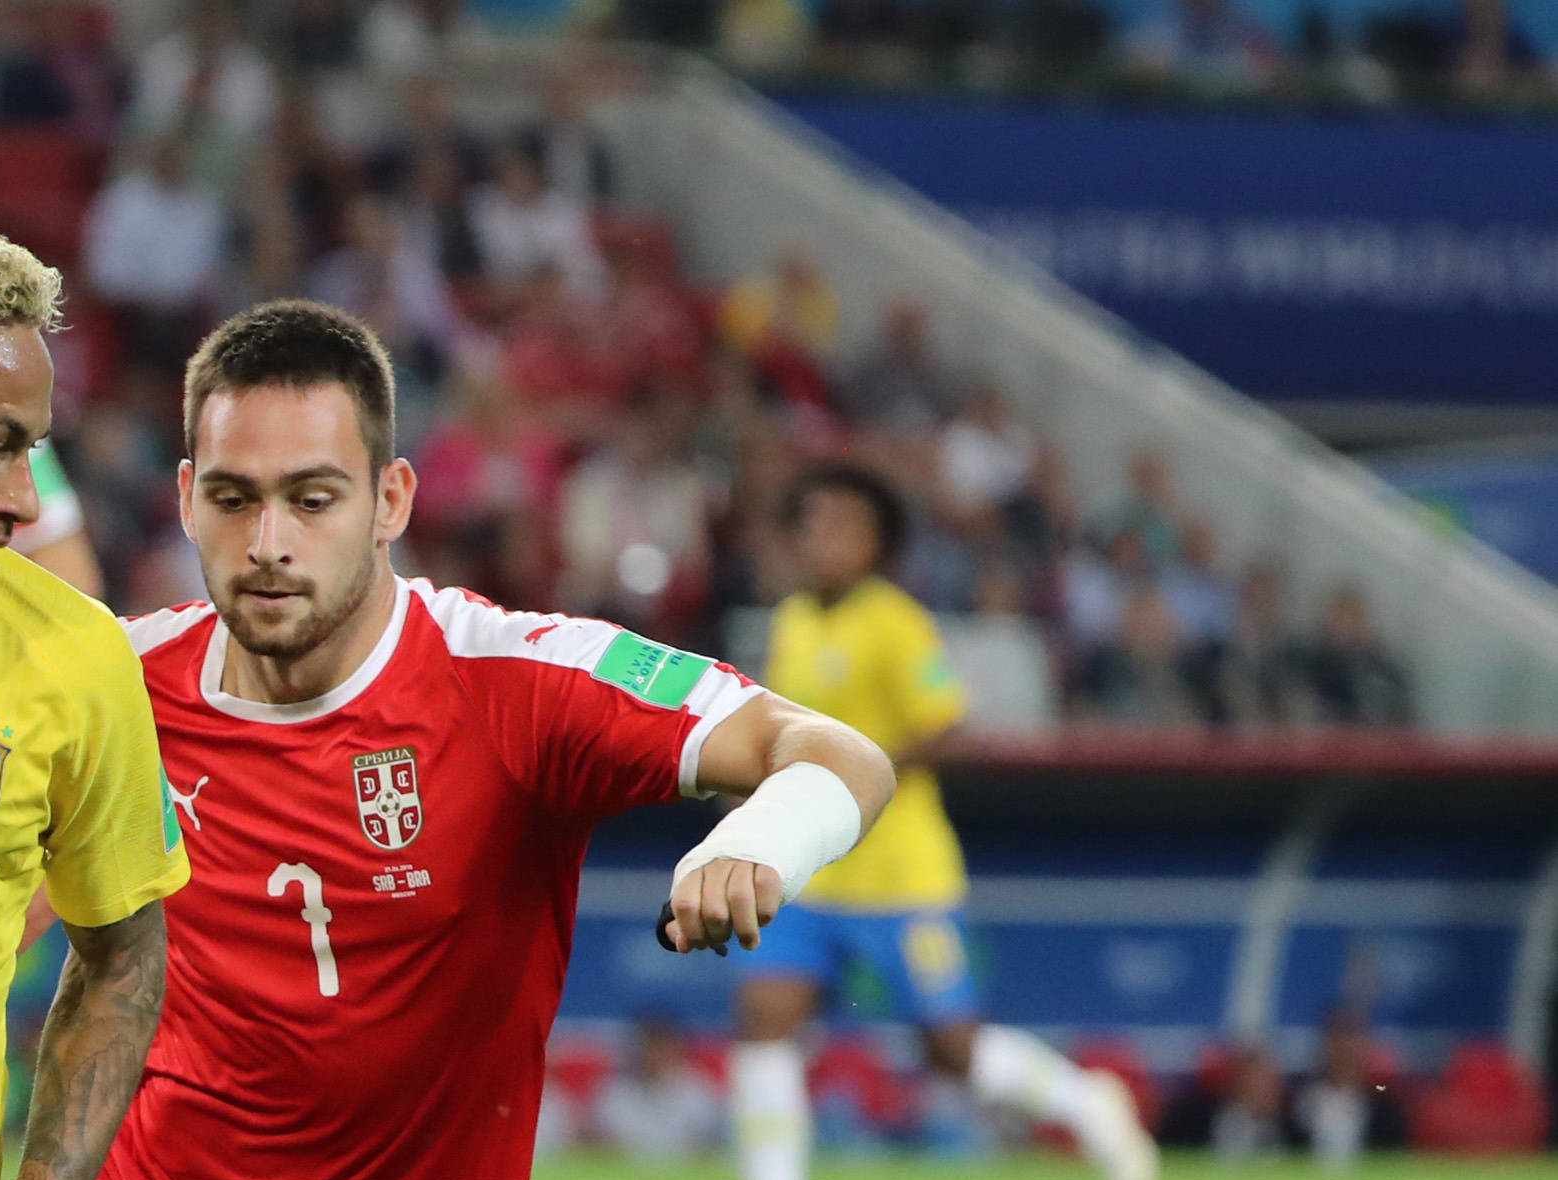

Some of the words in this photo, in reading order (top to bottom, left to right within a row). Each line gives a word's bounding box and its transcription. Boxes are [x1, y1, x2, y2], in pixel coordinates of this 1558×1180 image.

[354, 749, 411, 767] СРБИЈА
[372, 874, 396, 892] SRB
[406, 869, 432, 888] BRA
[267, 862, 340, 997] 7
